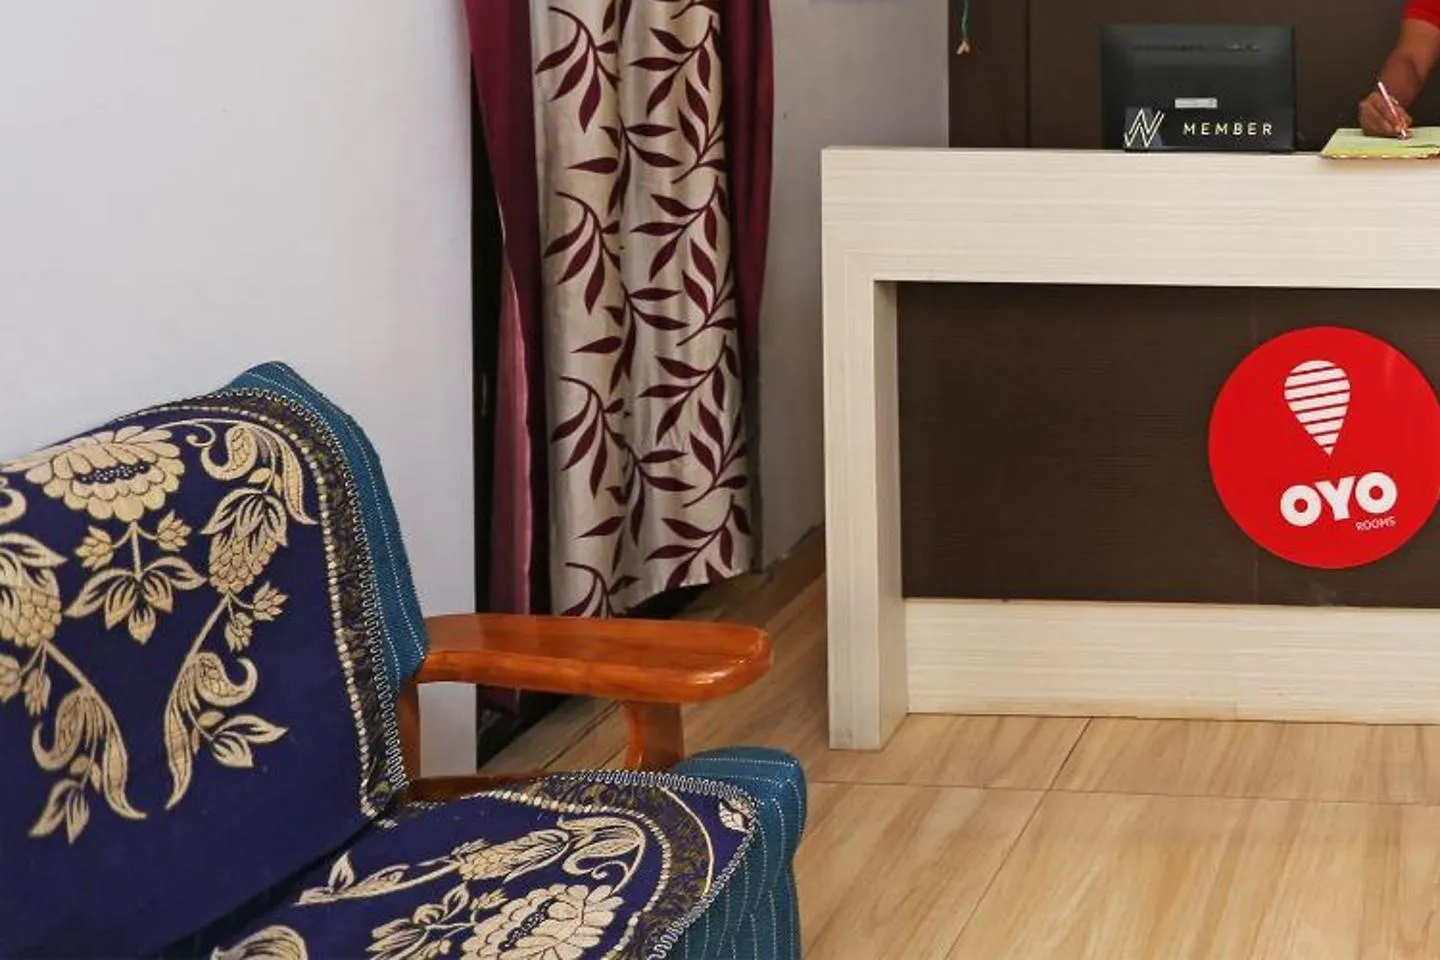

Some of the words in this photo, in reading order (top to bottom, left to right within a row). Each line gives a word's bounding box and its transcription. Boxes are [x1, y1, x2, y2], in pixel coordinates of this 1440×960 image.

[1182, 122, 1273, 136] MEMBER
[1280, 471, 1397, 527] OYO
[1355, 515, 1397, 531] ROOMS
